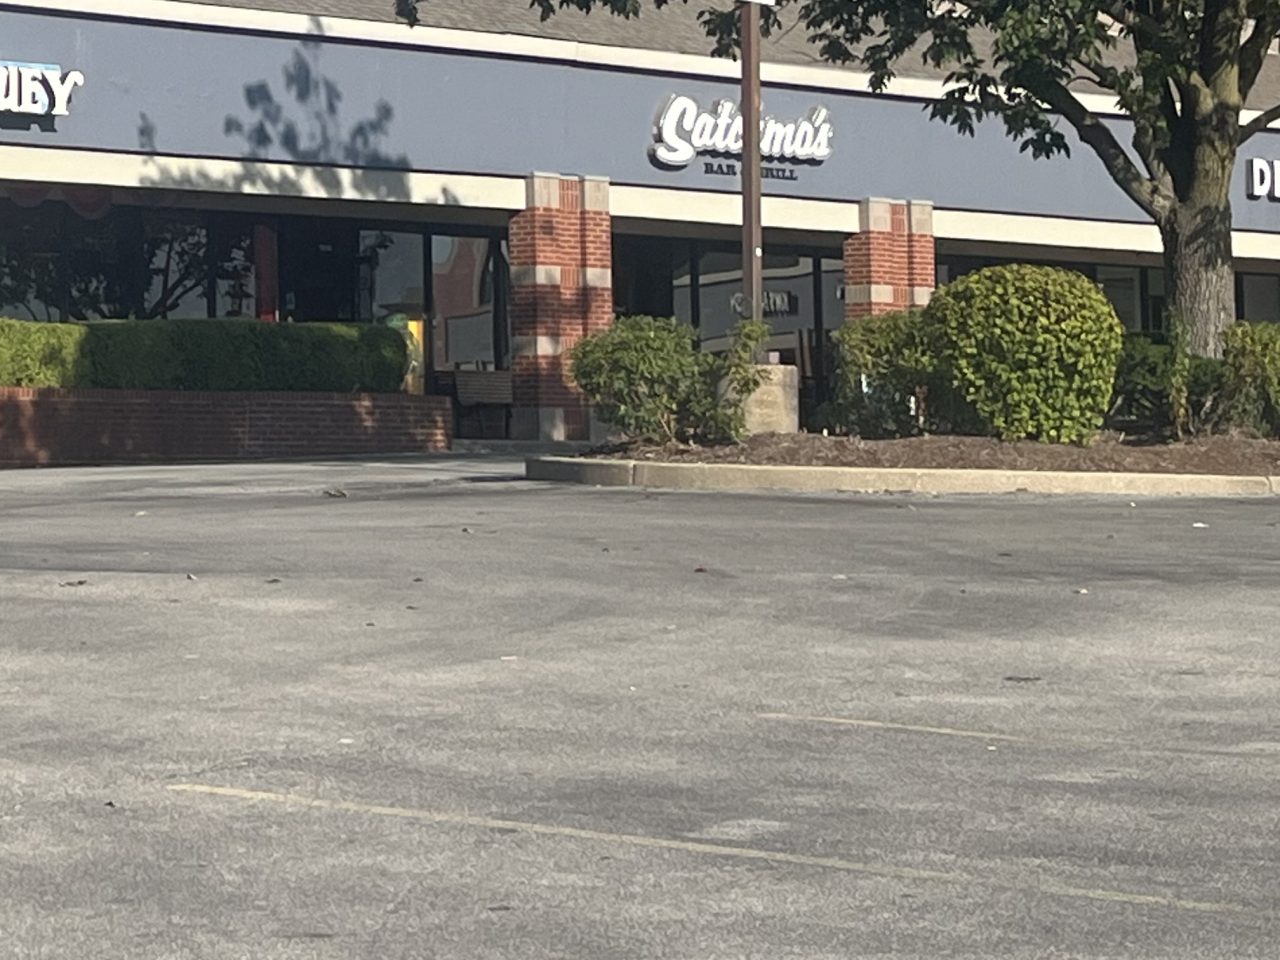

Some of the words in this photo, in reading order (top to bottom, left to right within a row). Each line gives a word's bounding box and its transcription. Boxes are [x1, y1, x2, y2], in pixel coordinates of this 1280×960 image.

[654, 94, 834, 165] Satcmo's
[704, 162, 738, 176] BAR
[760, 166, 798, 180] RILL
